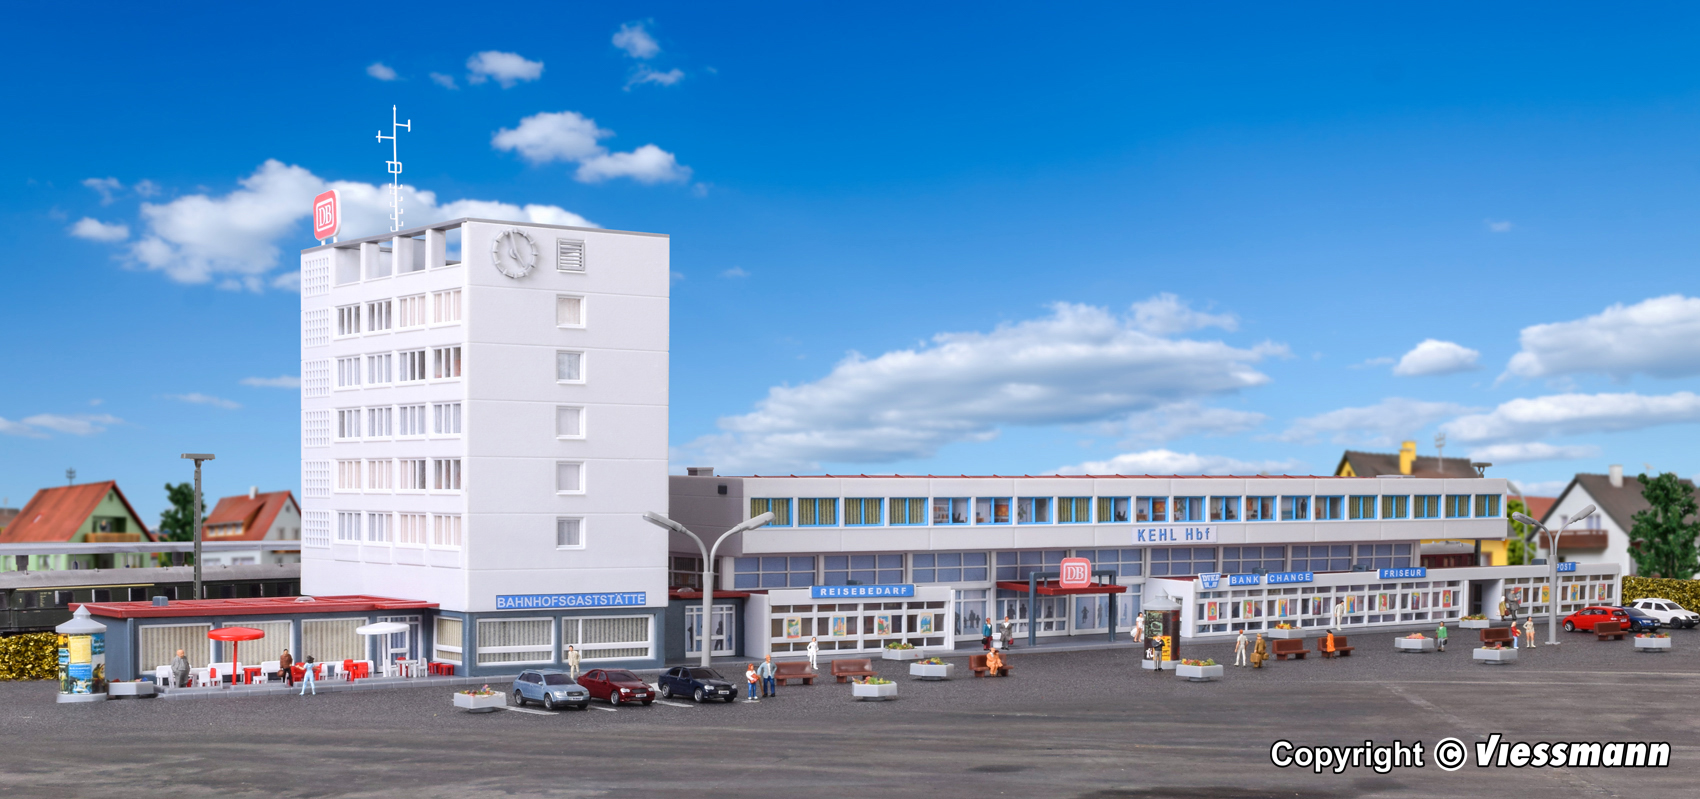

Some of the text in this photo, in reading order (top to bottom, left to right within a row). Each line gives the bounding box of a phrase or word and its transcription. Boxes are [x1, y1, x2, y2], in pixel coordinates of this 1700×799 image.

[318, 204, 331, 227] DB
[1137, 526, 1210, 542] KEHL Hbf
[1066, 566, 1085, 580] DB
[1269, 573, 1311, 582] CHANGE
[1384, 569, 1422, 578] FRISEUR
[1231, 576, 1259, 584] BANK
[819, 587, 907, 597] REISEBEDARF
[497, 593, 645, 606] BAHNHOFSGASTSTÄTTE
